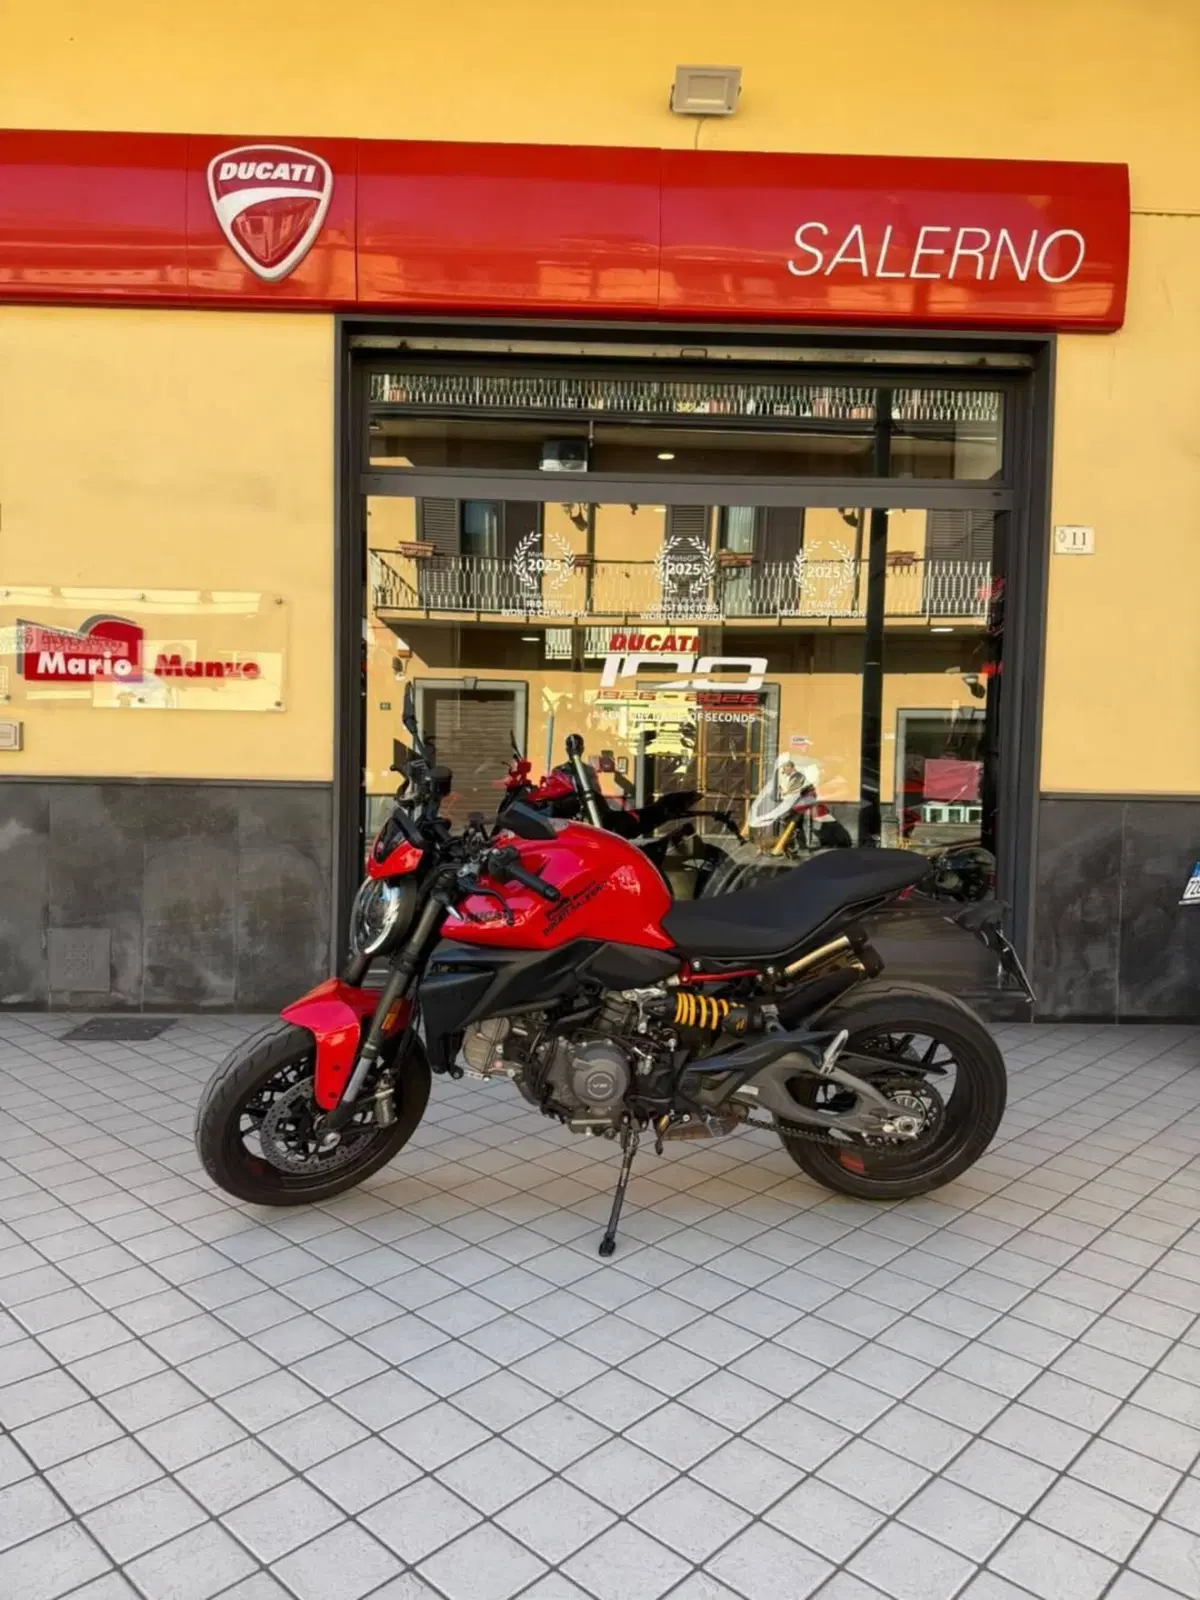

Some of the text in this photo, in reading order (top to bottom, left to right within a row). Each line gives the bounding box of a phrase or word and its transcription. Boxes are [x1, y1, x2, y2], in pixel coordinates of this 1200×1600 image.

[219, 161, 316, 183] DUCATI
[787, 221, 1086, 283] SALERNO
[1072, 531, 1086, 546] 11
[527, 559, 561, 571] 2025
[668, 563, 702, 575] 2025
[807, 567, 841, 578] 2025
[501, 608, 536, 617] WORLD
[648, 603, 720, 612] CONSTRUCTORS
[640, 612, 673, 620] WORLD
[609, 633, 700, 653] DUCATI
[37, 650, 133, 676] Mario
[596, 690, 657, 701] 1926
[705, 713, 757, 723] SECONDS
